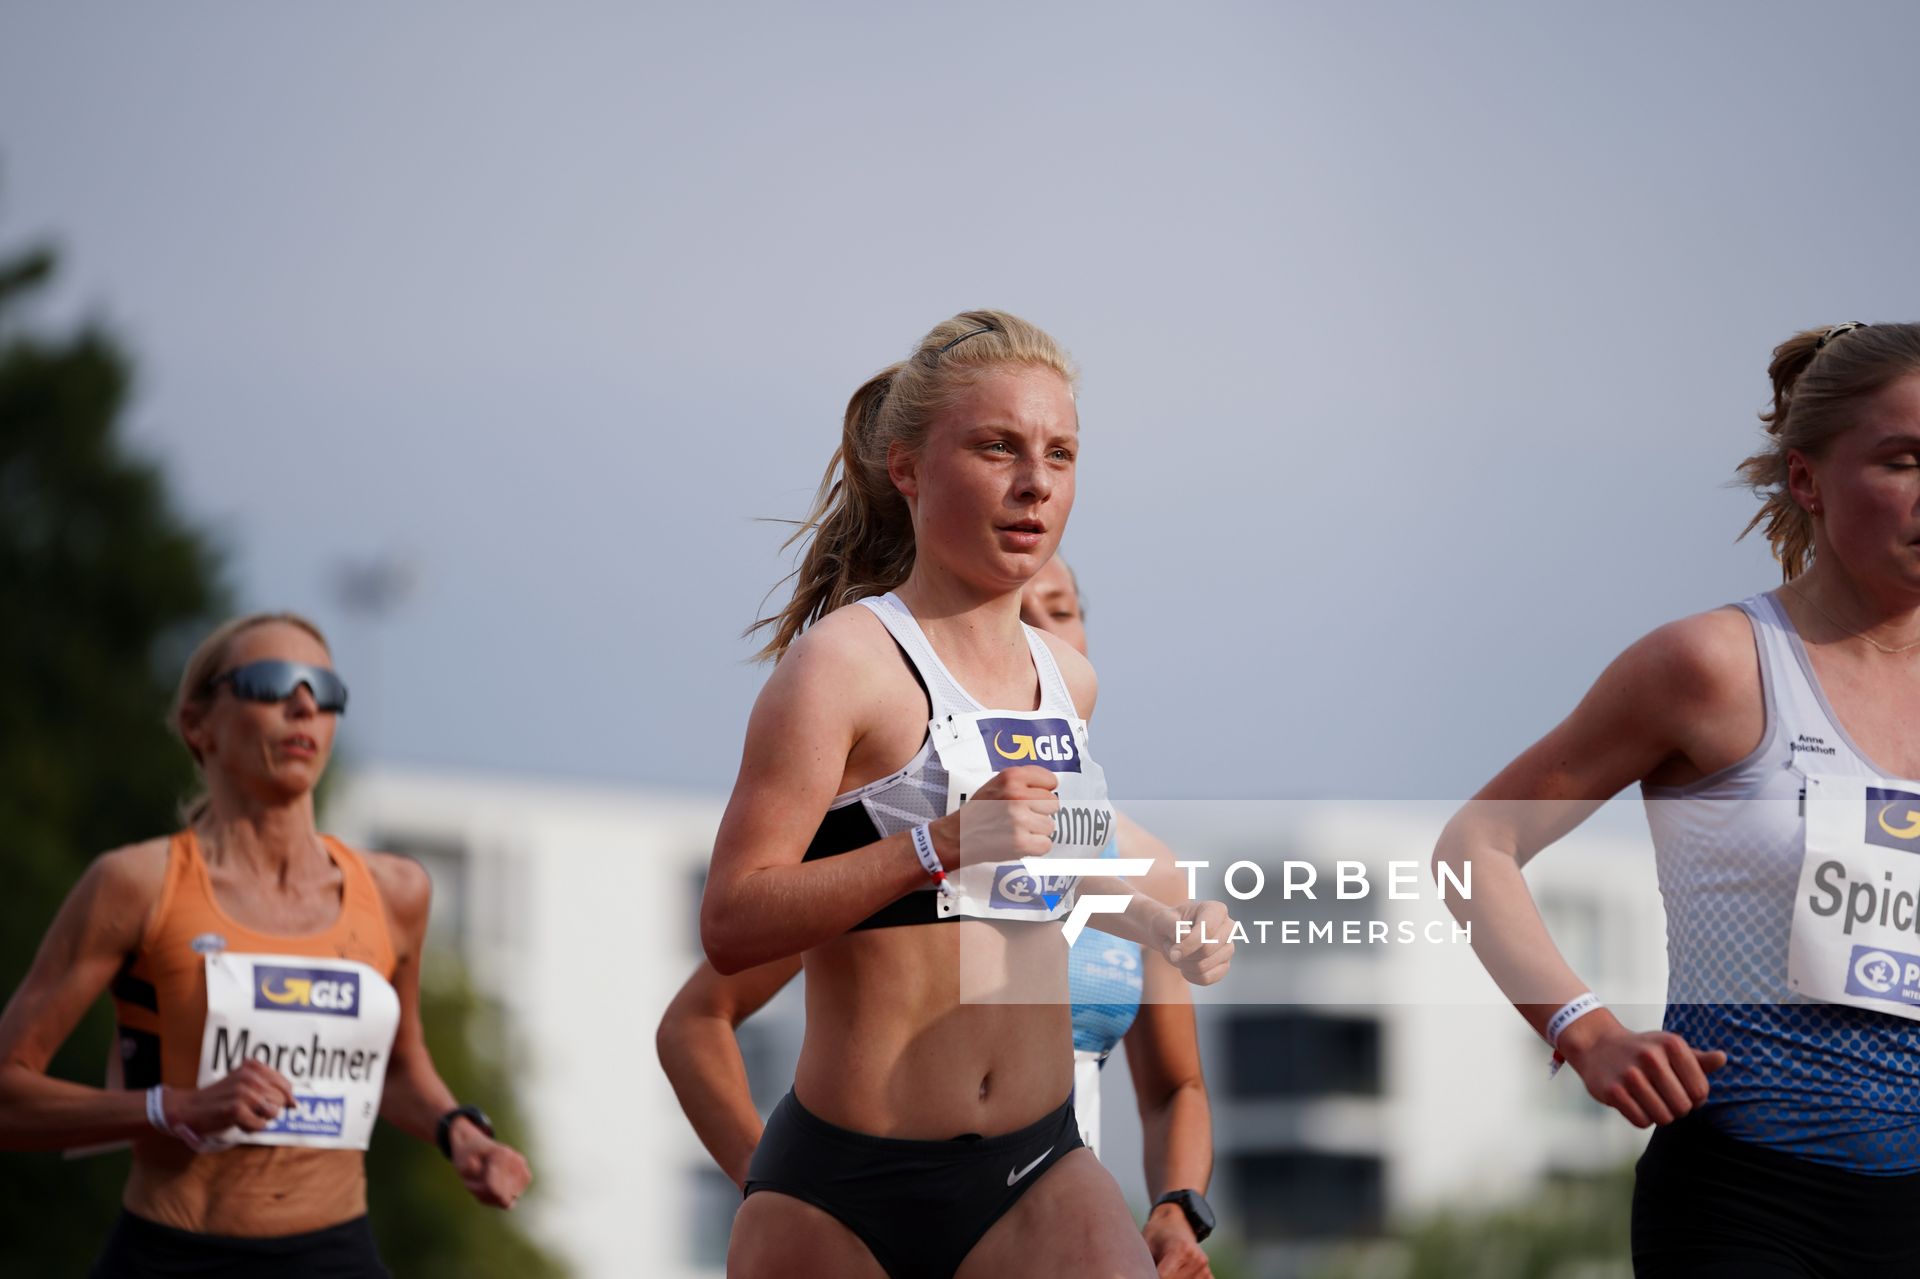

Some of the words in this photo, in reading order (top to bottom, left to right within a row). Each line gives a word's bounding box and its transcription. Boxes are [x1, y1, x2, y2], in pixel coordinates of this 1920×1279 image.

[1035, 735, 1074, 761] GLS
[1799, 734, 1824, 744] Anne
[1809, 860, 1920, 935] Spic
[310, 980, 355, 1010] GLS
[212, 1027, 379, 1083] Morchner
